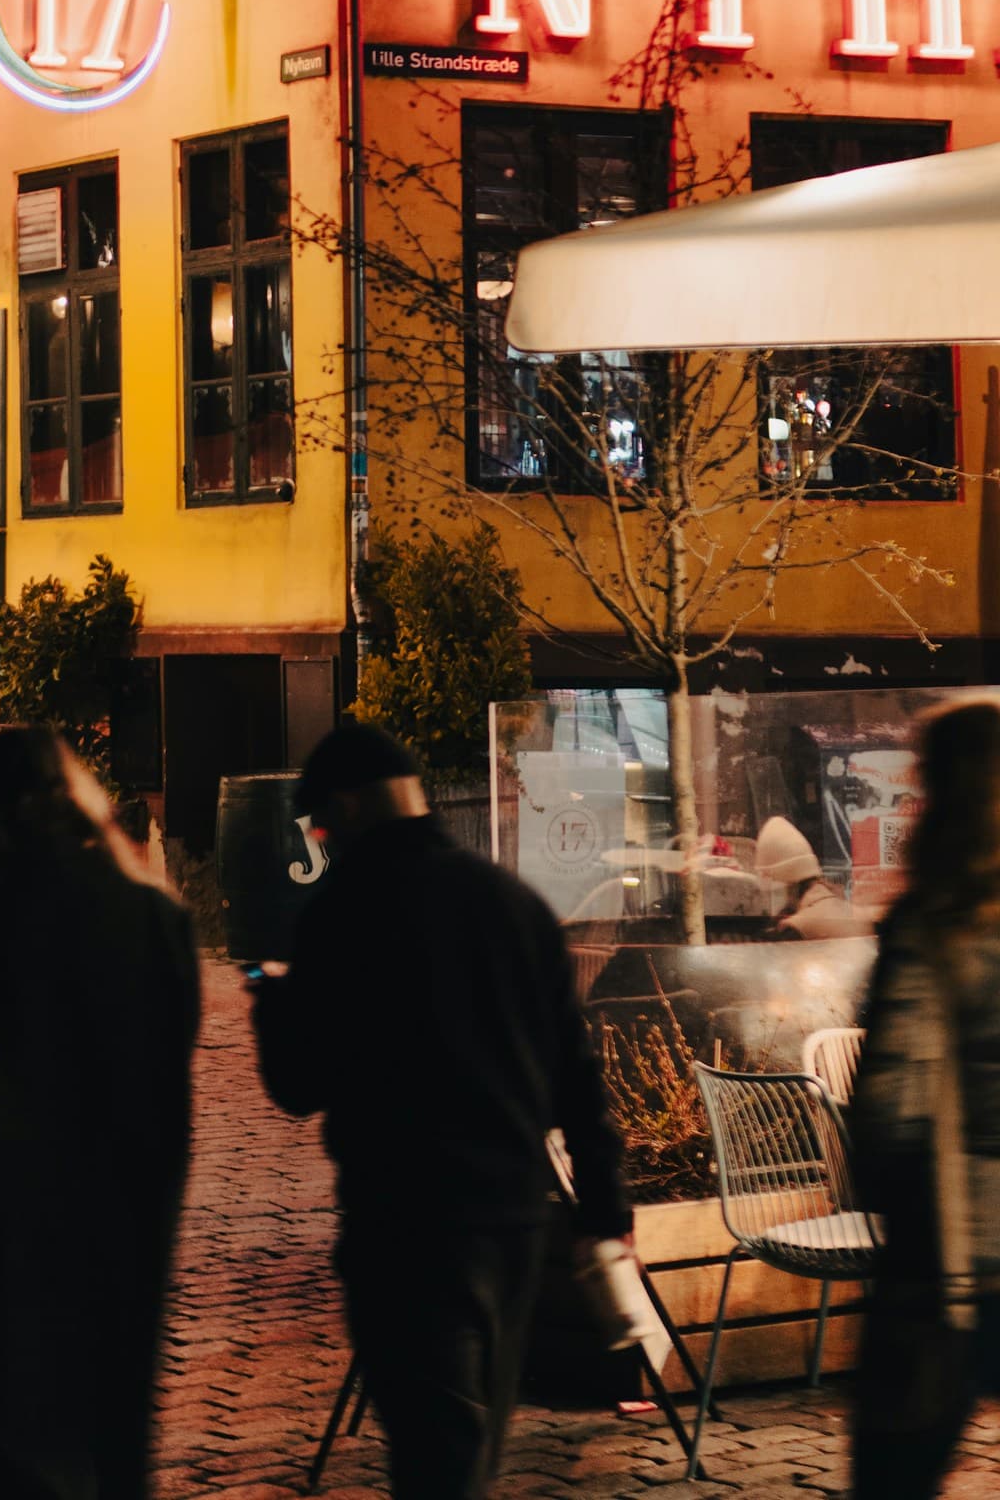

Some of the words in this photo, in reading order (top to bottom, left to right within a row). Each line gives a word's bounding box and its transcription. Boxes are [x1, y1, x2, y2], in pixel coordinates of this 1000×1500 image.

[284, 55, 323, 76] Nyhavn
[371, 50, 405, 68] Lille
[409, 52, 520, 74] Strandstræde
